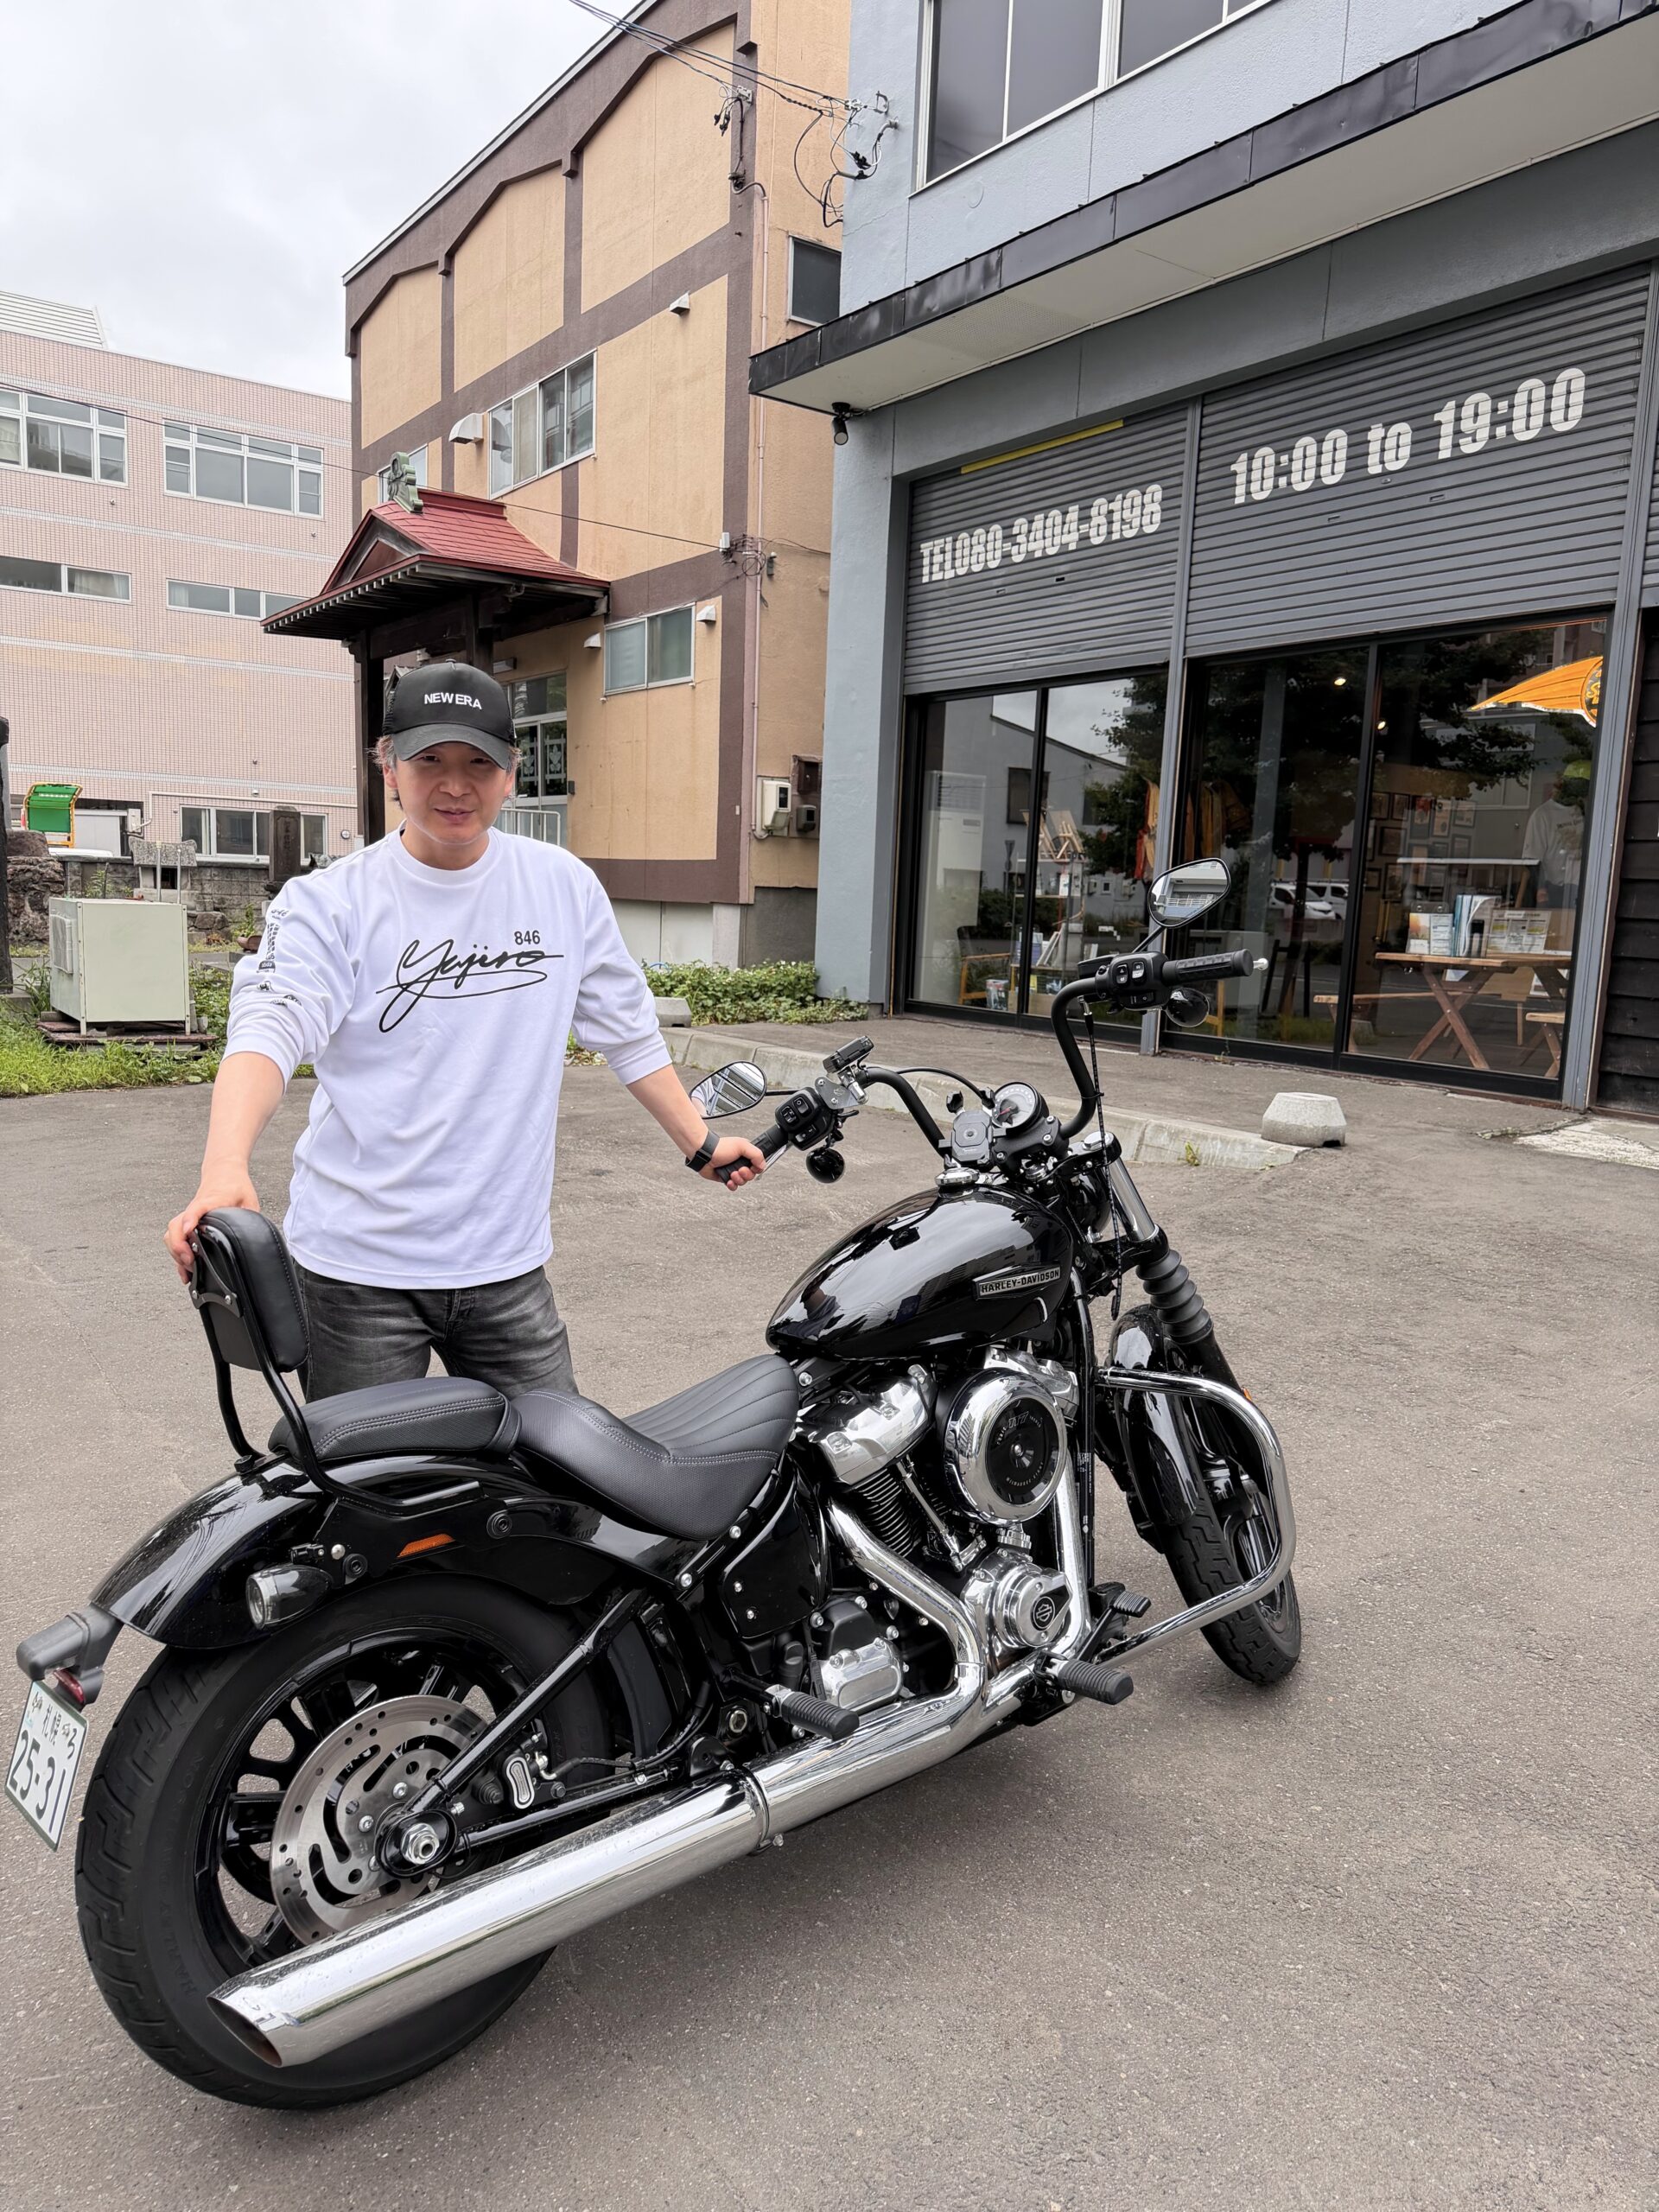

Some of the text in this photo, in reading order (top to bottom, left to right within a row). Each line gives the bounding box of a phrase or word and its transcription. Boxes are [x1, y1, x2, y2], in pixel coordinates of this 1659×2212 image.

[1230, 367, 1586, 505] 10:00 to 19:00
[920, 484, 1163, 584] TEL080-3404-8198
[424, 692, 482, 709] NEW ERA
[514, 930, 541, 945] 846
[981, 1268, 1060, 1294] HARLEY-DAVIDSON
[41, 1703, 61, 1746] 札幌
